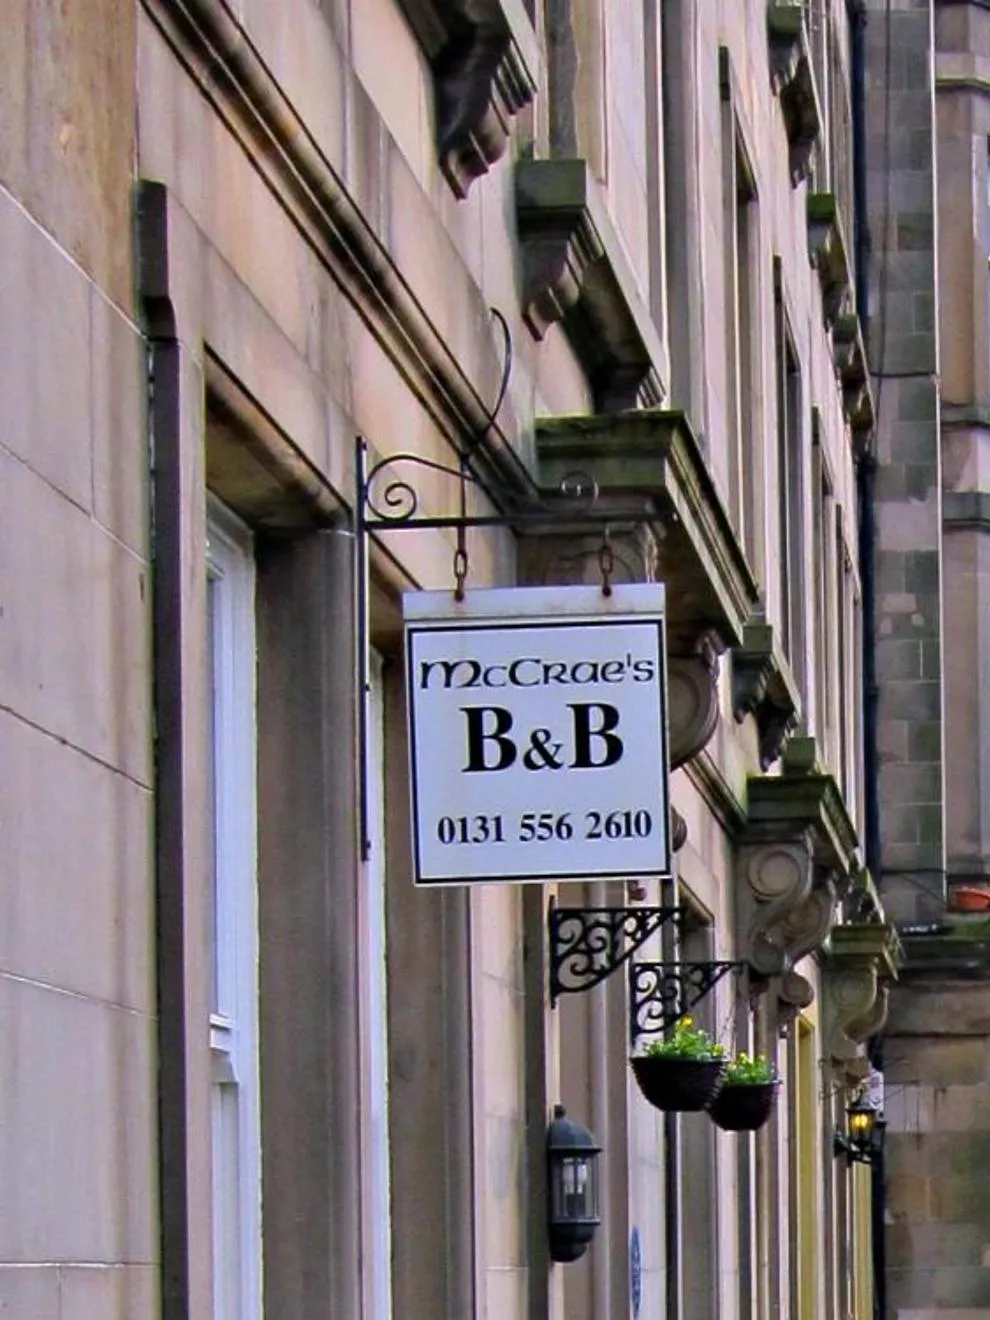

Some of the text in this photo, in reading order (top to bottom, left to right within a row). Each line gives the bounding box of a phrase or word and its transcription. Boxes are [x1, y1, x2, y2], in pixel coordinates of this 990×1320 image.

[420, 653, 654, 689] McCrae's
[459, 702, 625, 773] B&B
[437, 809, 652, 844] 0131 556 2610
